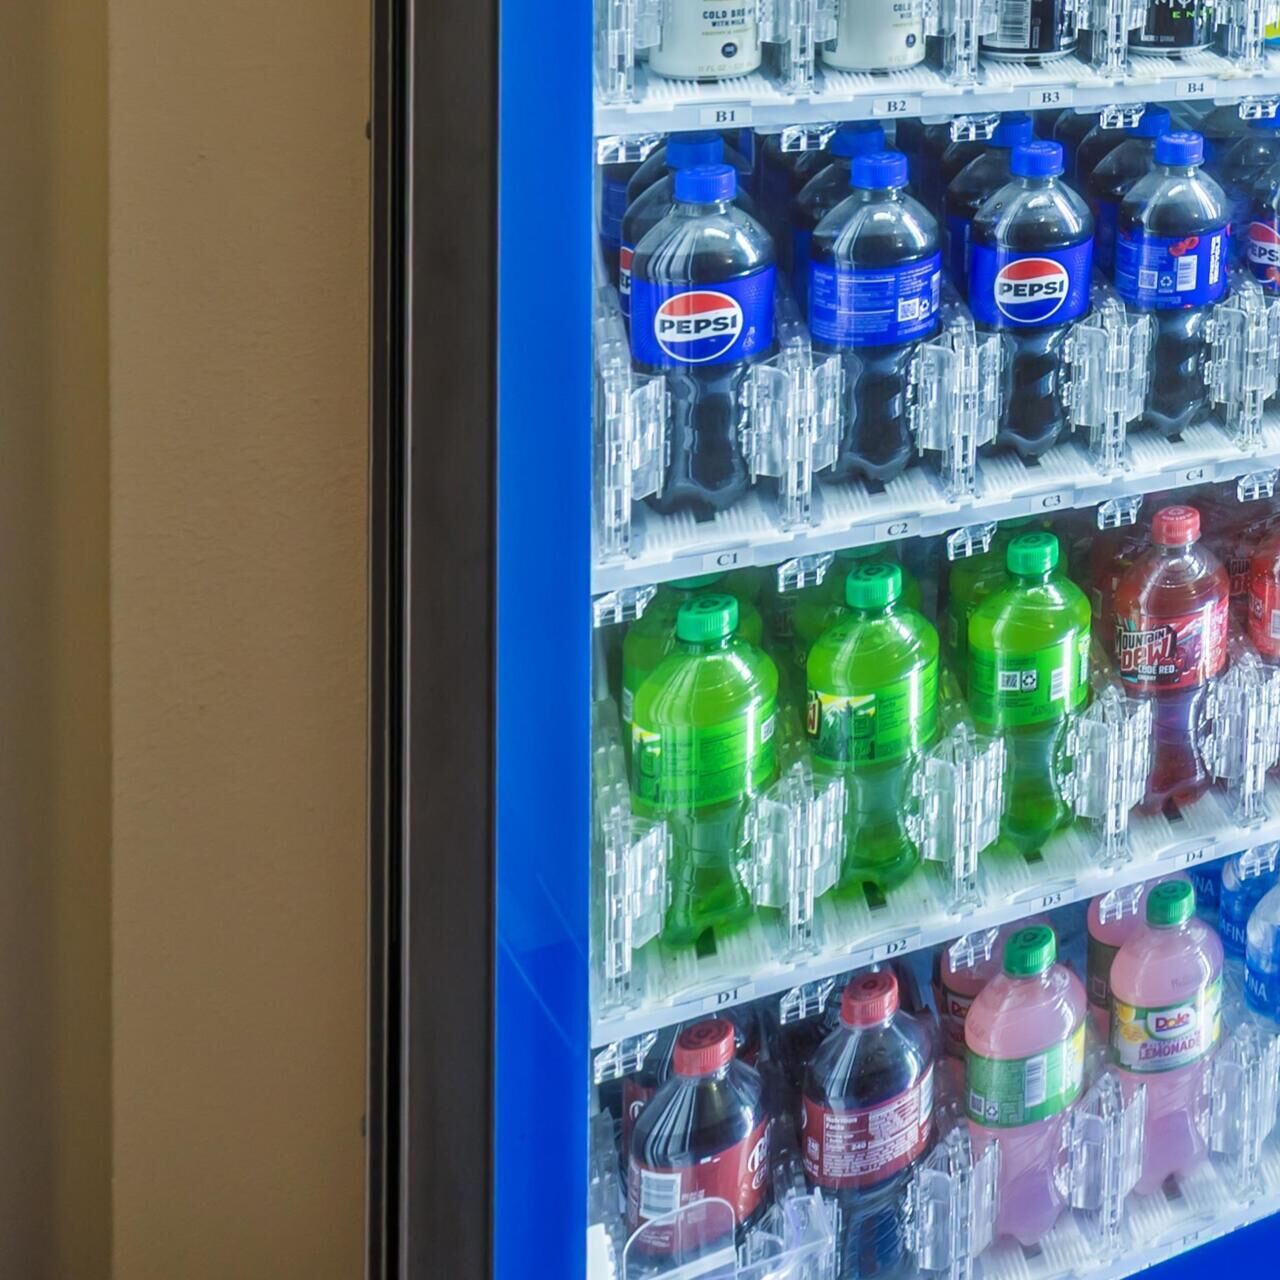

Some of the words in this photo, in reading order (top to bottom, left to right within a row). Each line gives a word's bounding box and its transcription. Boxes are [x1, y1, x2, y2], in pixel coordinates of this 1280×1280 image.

[702, 10, 728, 20] COLD
[1187, 82, 1205, 93] B4
[1042, 91, 1061, 103] B3
[887, 100, 907, 112] B2
[715, 110, 736, 122] B1
[1001, 279, 1064, 297] PEPSI
[659, 314, 737, 335] PEPSI
[1185, 469, 1203, 481] C4
[1042, 494, 1062, 507] C3
[887, 522, 908, 536] C2
[716, 552, 738, 566] C1
[1158, 663, 1176, 674] RED
[1185, 851, 1203, 863] D4
[1042, 893, 1062, 906] D3
[887, 939, 908, 954] D2
[717, 989, 738, 1005] D1
[1155, 1012, 1190, 1032] Dole
[1137, 1040, 1197, 1061] LEMONAD
